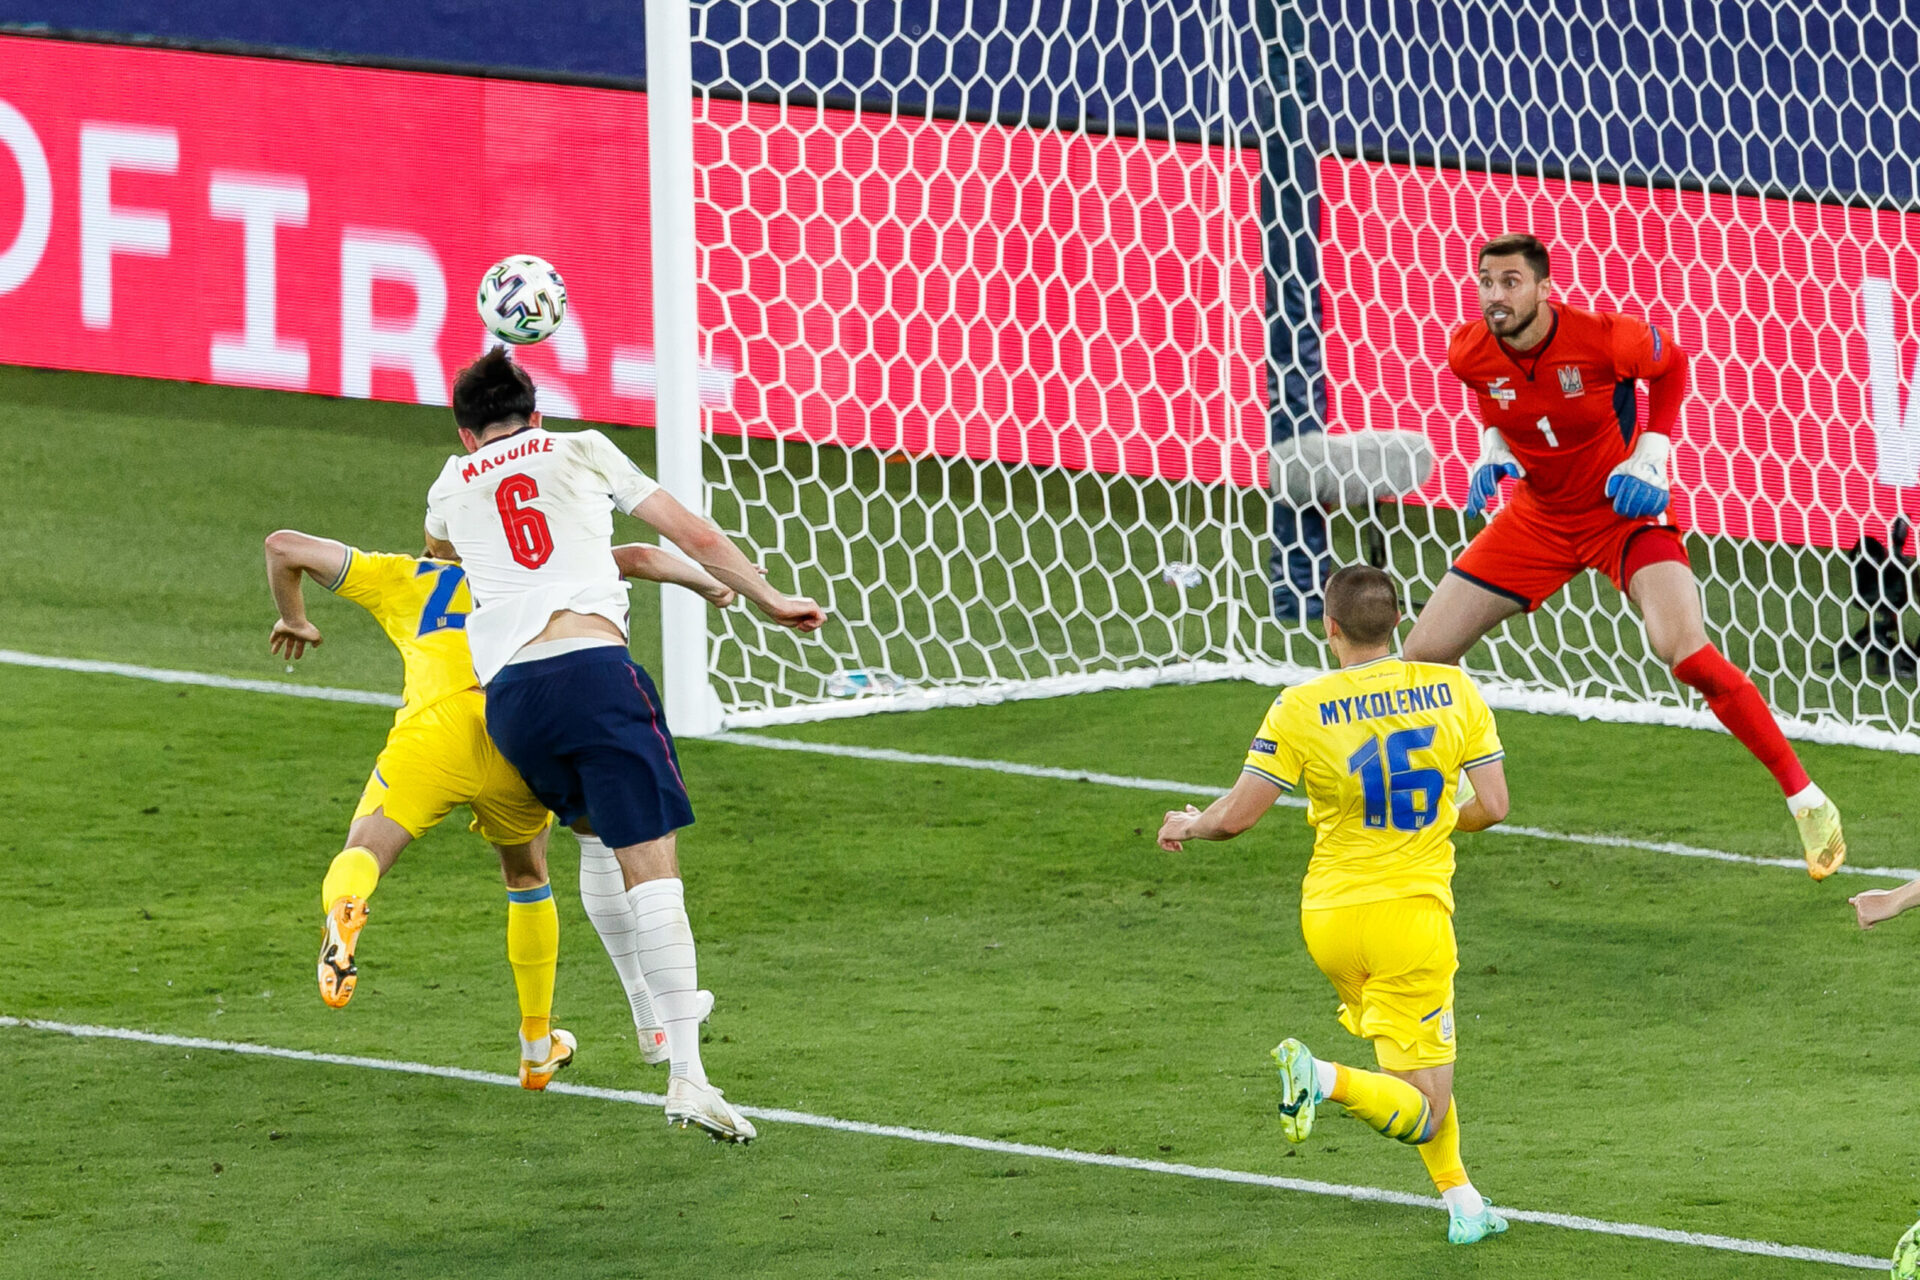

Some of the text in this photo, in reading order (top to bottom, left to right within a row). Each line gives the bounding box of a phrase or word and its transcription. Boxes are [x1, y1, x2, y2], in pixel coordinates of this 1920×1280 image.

[1536, 415, 1559, 447] 1
[495, 473, 554, 570] 6
[1319, 682, 1453, 726] MYKOLENKO
[1348, 725, 1444, 832] 16
